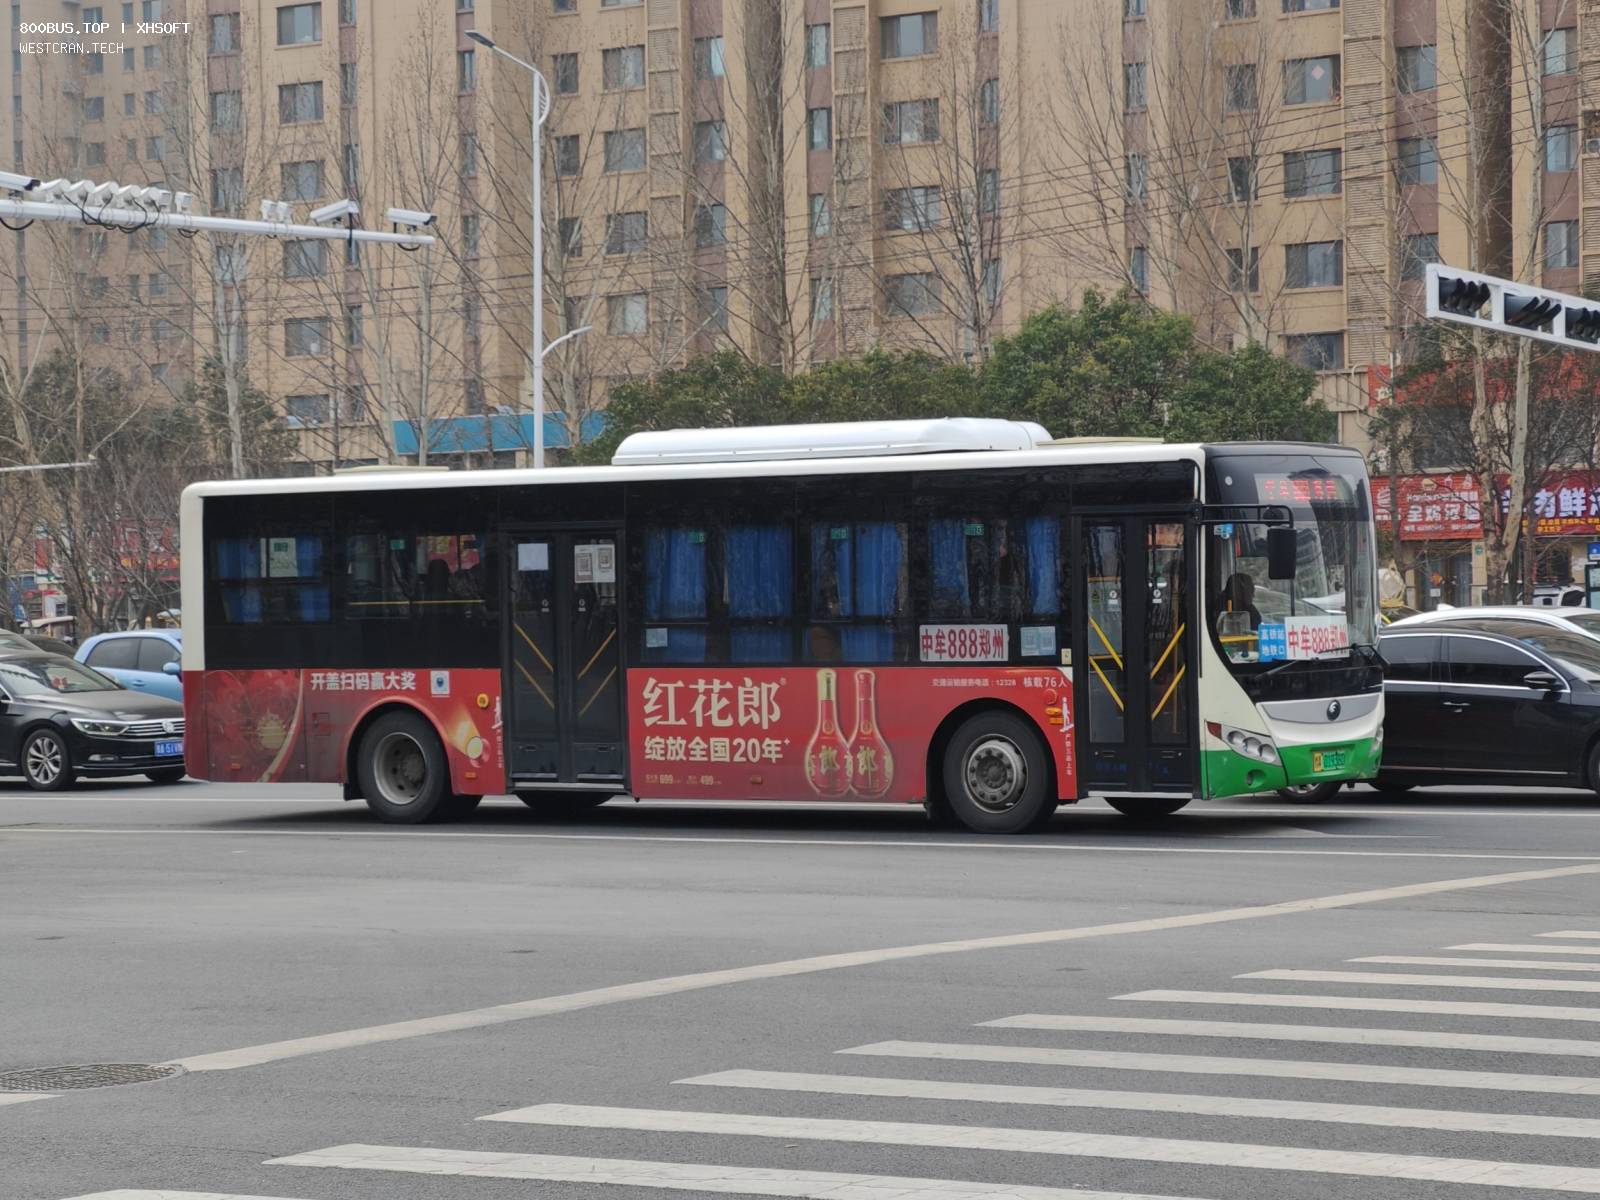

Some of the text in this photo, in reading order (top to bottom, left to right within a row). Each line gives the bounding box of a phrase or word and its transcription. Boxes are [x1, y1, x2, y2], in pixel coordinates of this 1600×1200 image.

[921, 628, 1004, 660] 中牟888郑州
[310, 671, 417, 691] 开盖扫码赢大奖
[1023, 676, 1068, 688] 核载76人
[642, 677, 781, 729] 红花郎
